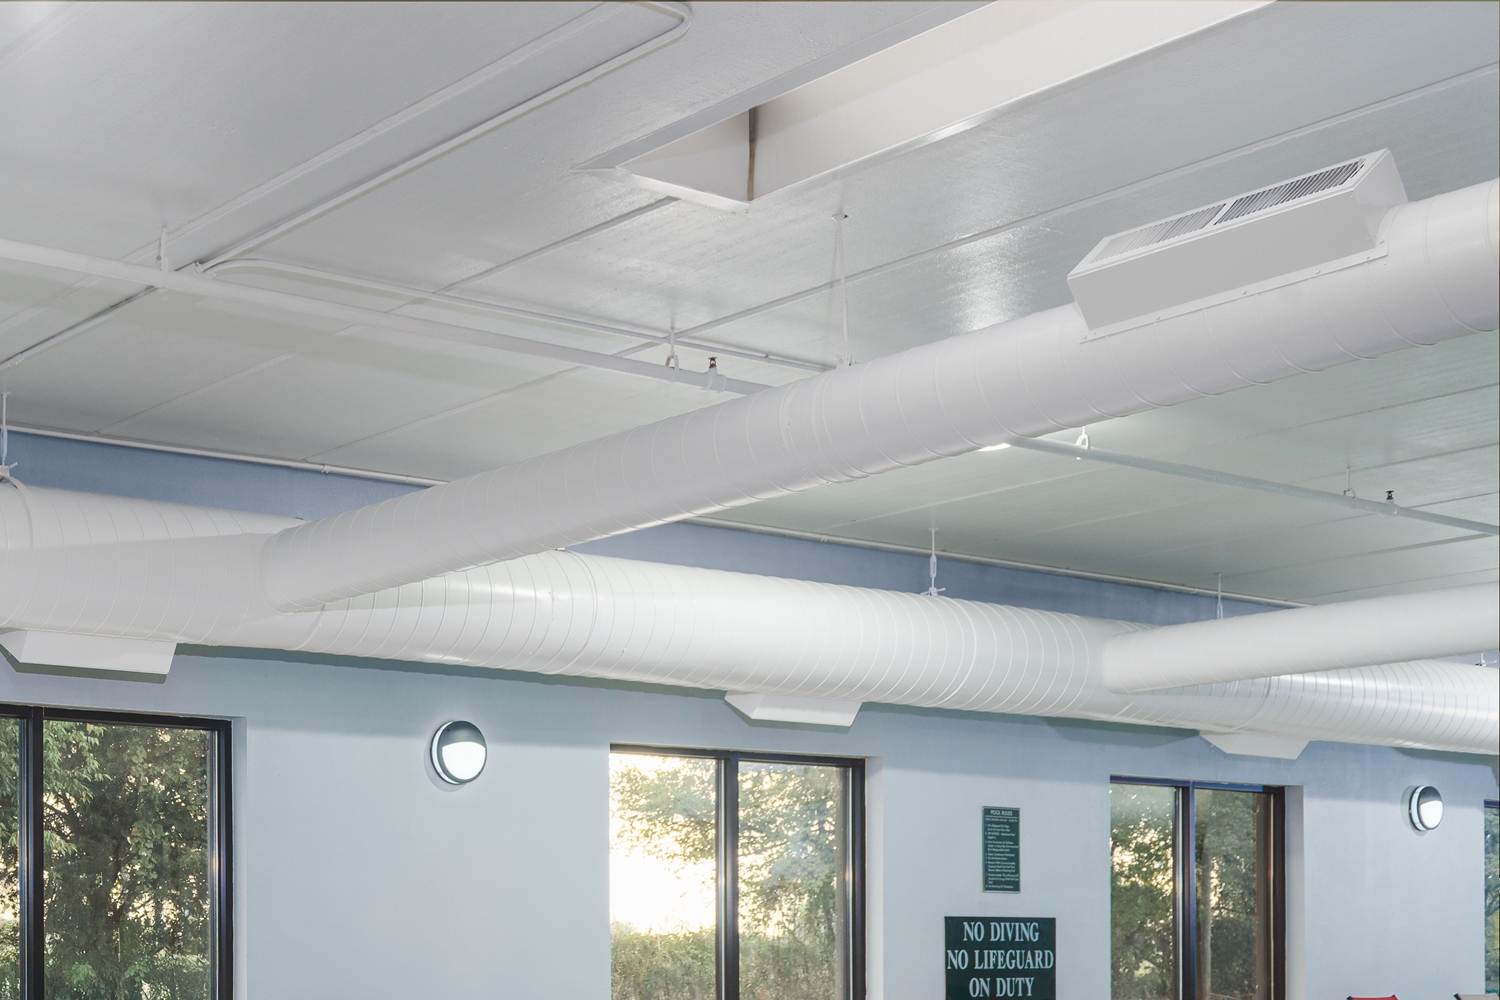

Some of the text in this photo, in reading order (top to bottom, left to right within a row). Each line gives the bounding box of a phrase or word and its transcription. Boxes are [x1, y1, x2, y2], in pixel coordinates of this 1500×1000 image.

[963, 922, 1039, 942] NO DIVING
[947, 950, 1054, 970] NO LIFEGUARD
[969, 977, 1034, 997] ON DUTY
